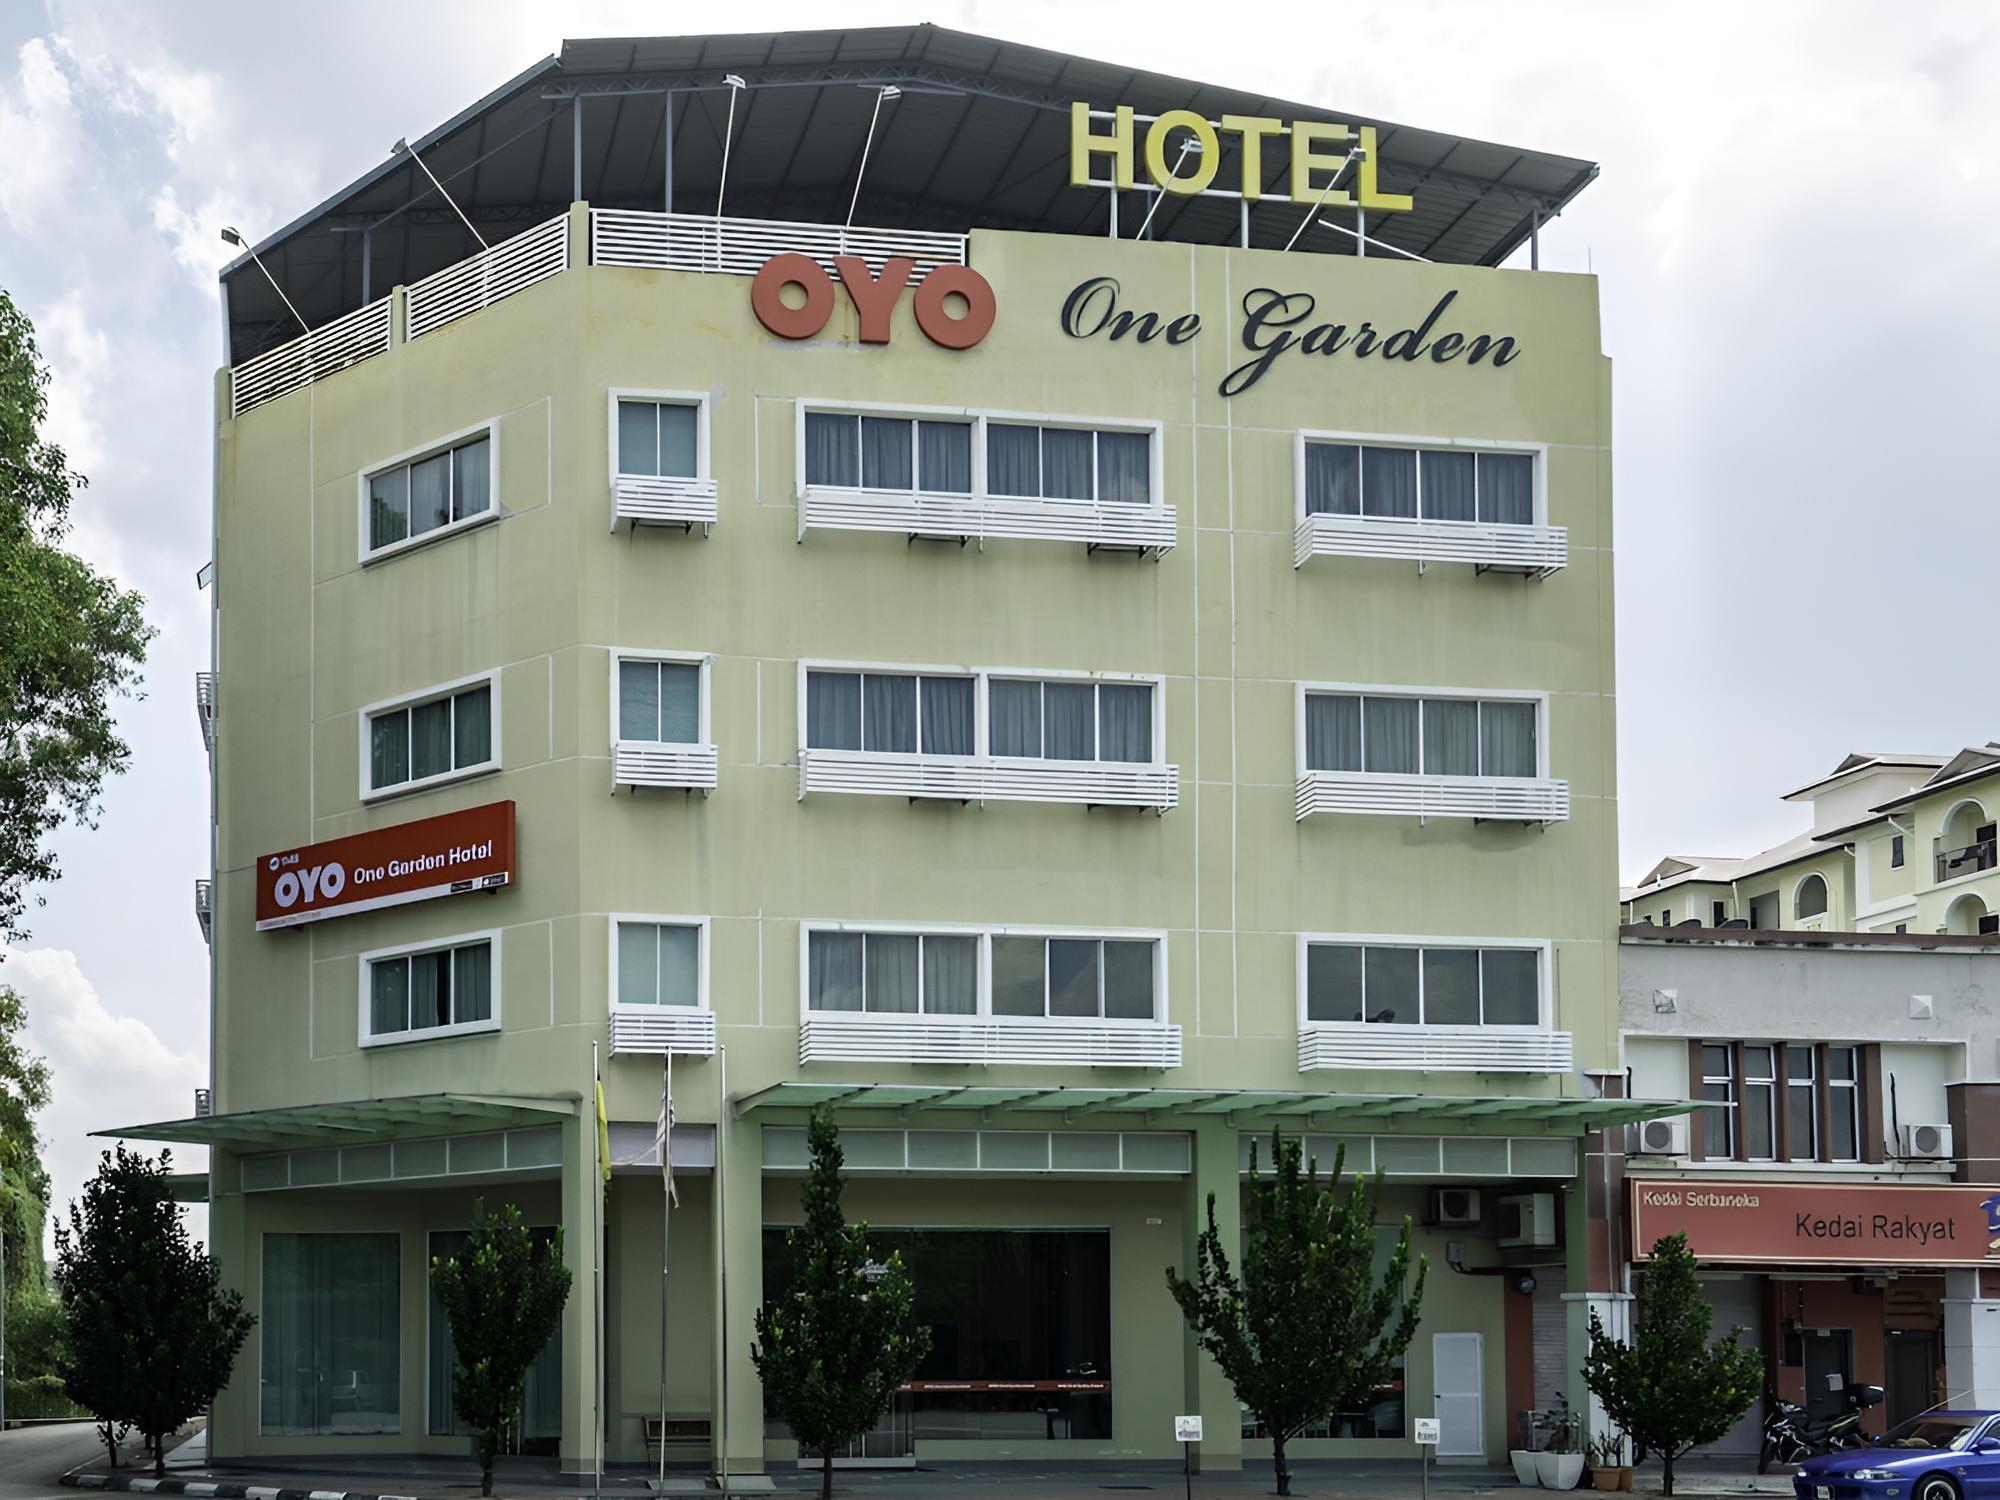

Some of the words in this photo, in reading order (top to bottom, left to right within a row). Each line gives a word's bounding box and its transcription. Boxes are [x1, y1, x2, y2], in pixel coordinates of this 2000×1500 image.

[1071, 102, 1413, 210] HOTEL
[751, 253, 997, 350] OYO
[1061, 277, 1202, 346] One
[1219, 288, 1522, 397] Garden
[274, 862, 346, 908] OYO
[1795, 1213, 1863, 1238] Kedai
[1872, 1214, 1956, 1246] Rakyat
